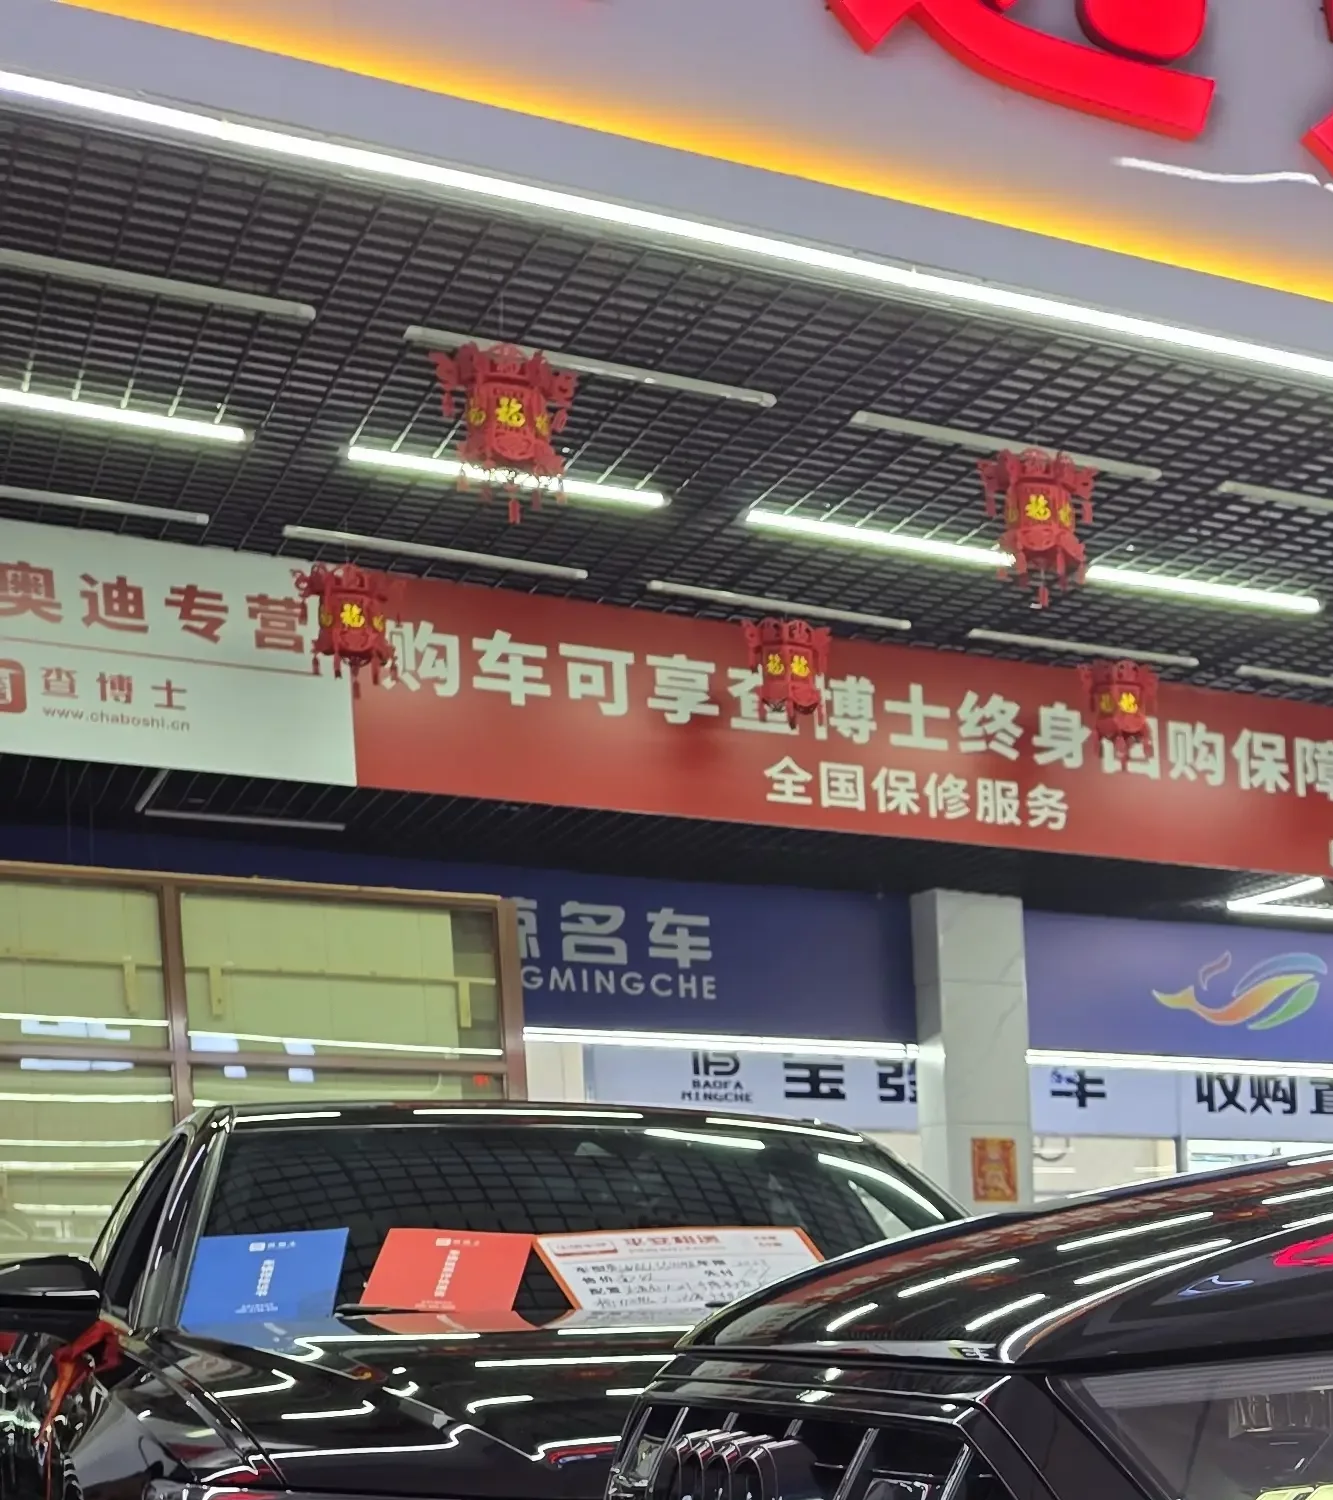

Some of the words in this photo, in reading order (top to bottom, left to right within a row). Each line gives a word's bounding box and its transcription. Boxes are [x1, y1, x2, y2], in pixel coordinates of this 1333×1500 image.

[40, 667, 188, 711] 查博士
[42, 704, 191, 732] www.chaboshi.cn
[763, 755, 1068, 830] 全国保修服务
